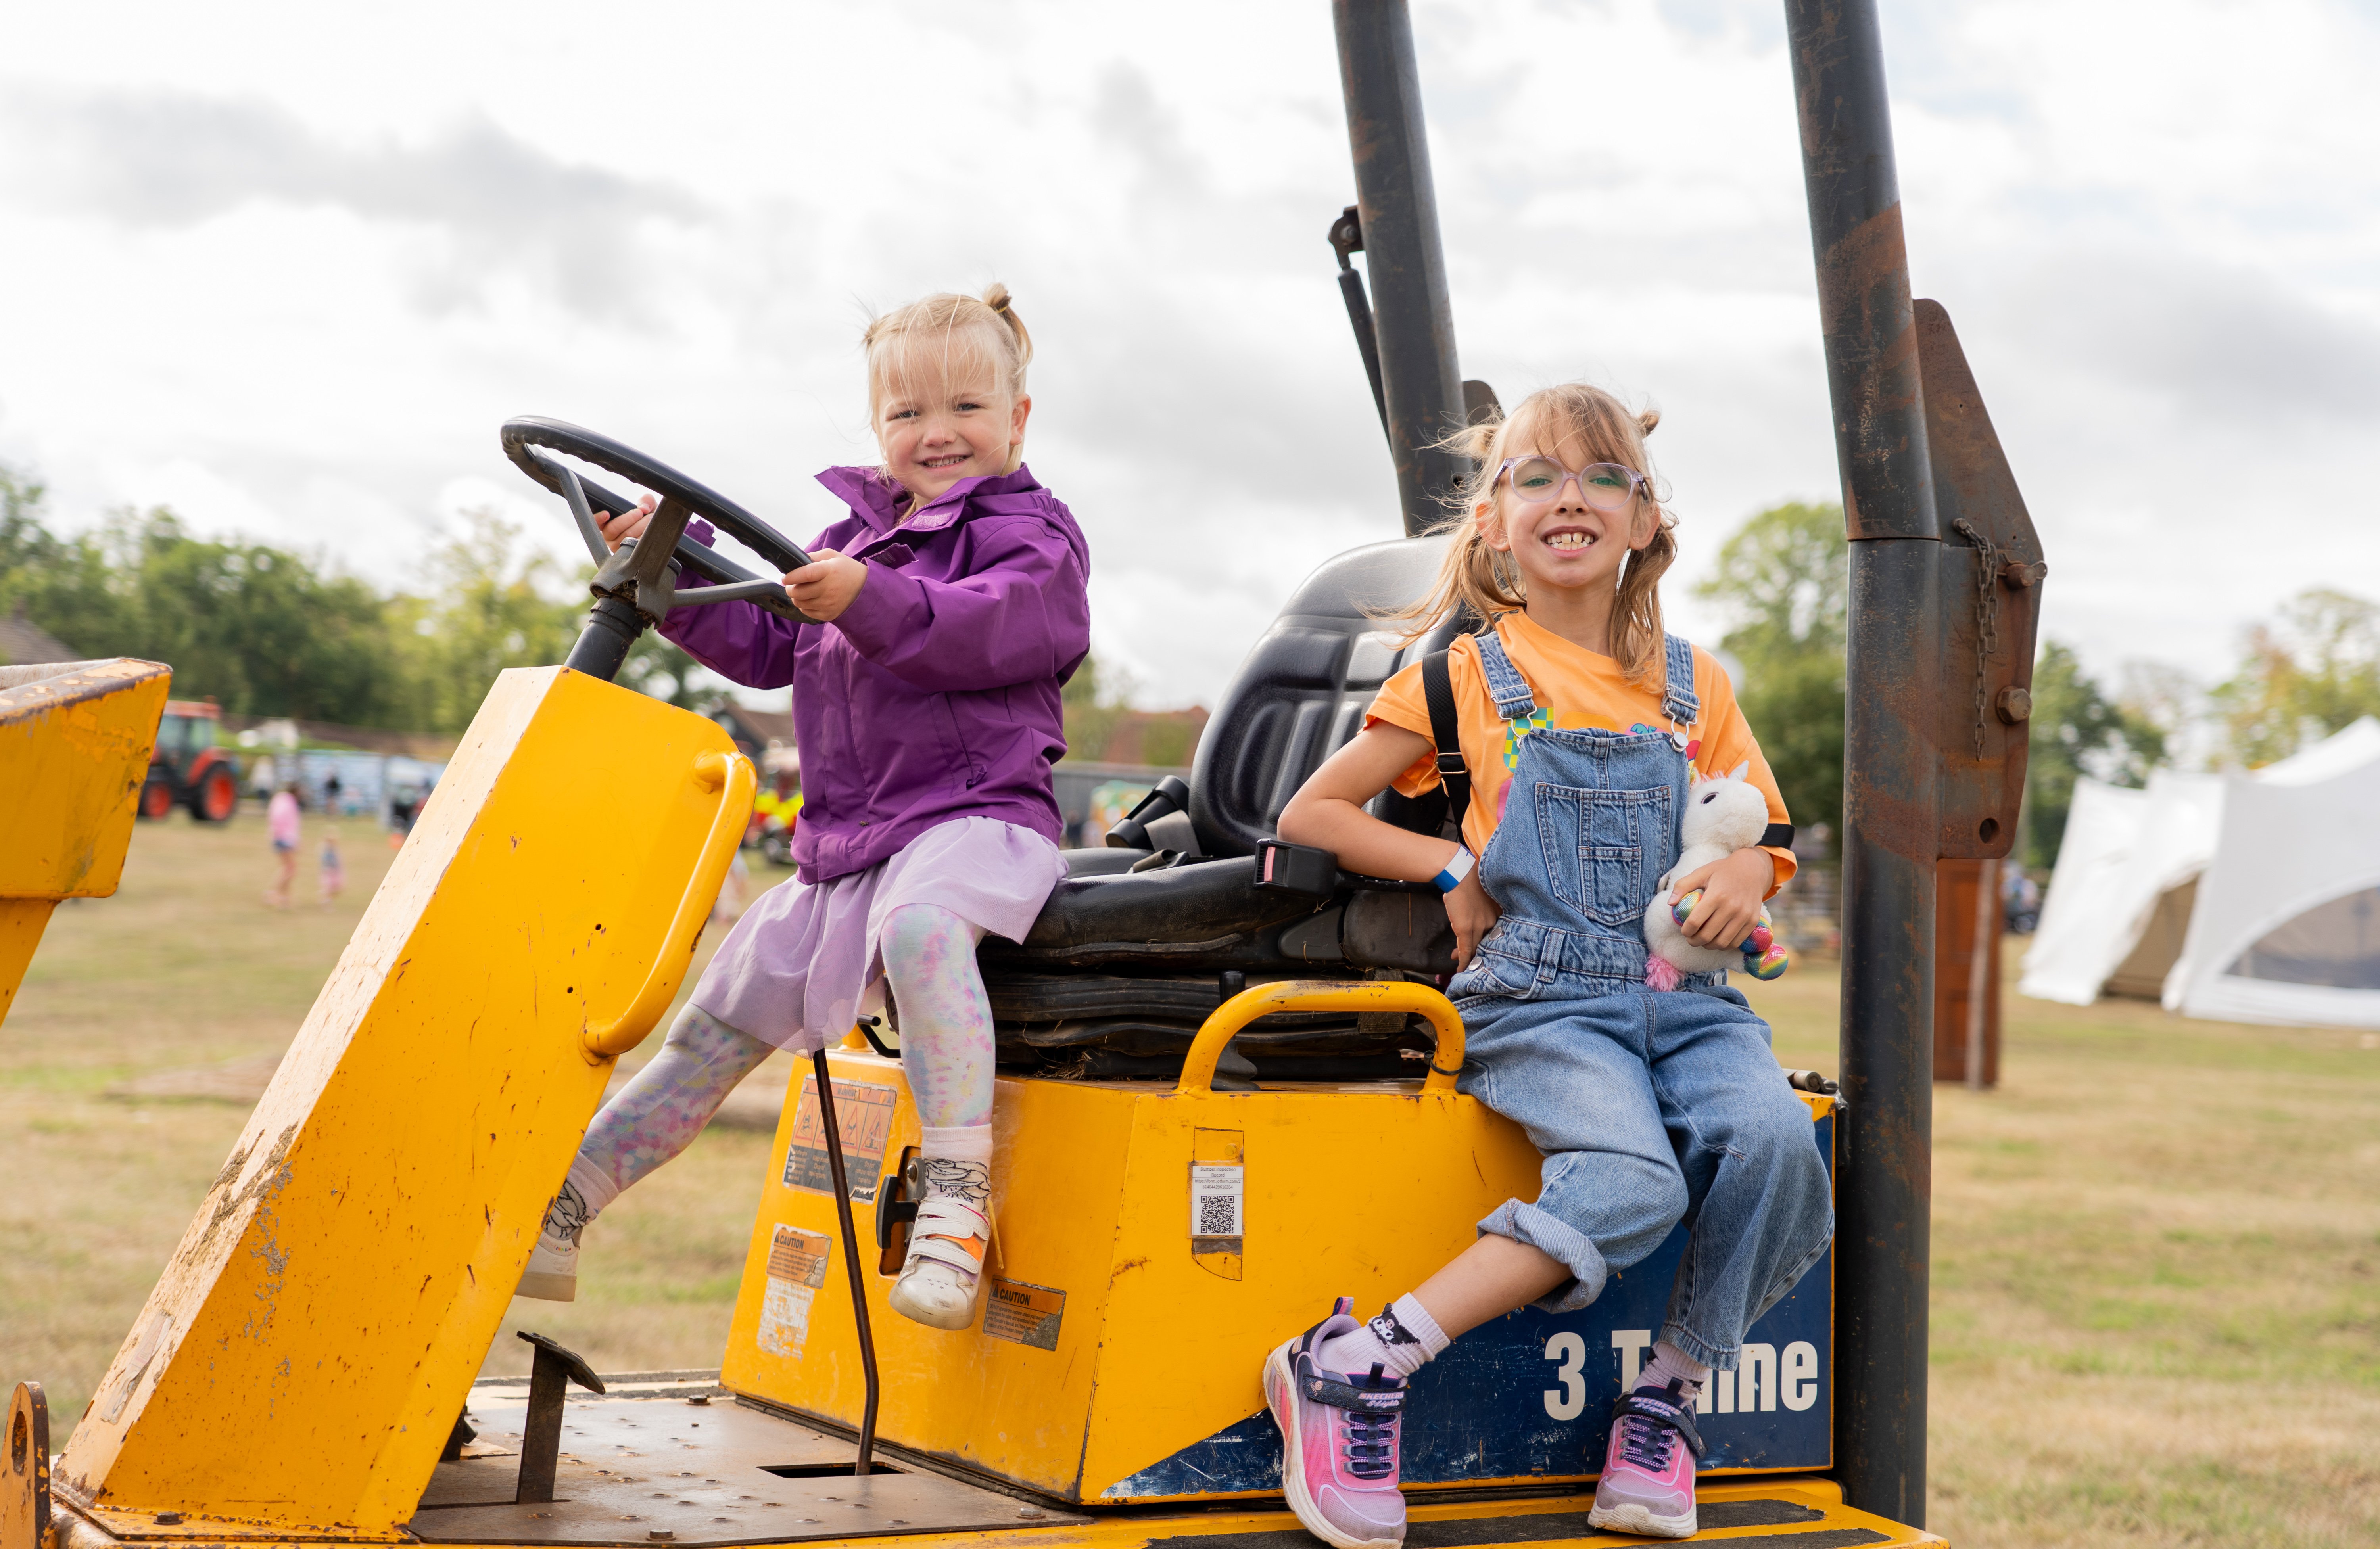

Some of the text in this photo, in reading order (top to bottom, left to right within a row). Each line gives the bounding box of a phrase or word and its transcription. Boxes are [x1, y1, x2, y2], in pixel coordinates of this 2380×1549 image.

[780, 1235, 804, 1250] CAUTION
[1000, 1288, 1031, 1306] CAUTION
[1544, 1332, 1586, 1420] 3
[1359, 1391, 1404, 1400] SKECHERS
[1629, 1397, 1681, 1415] SKECHERS
